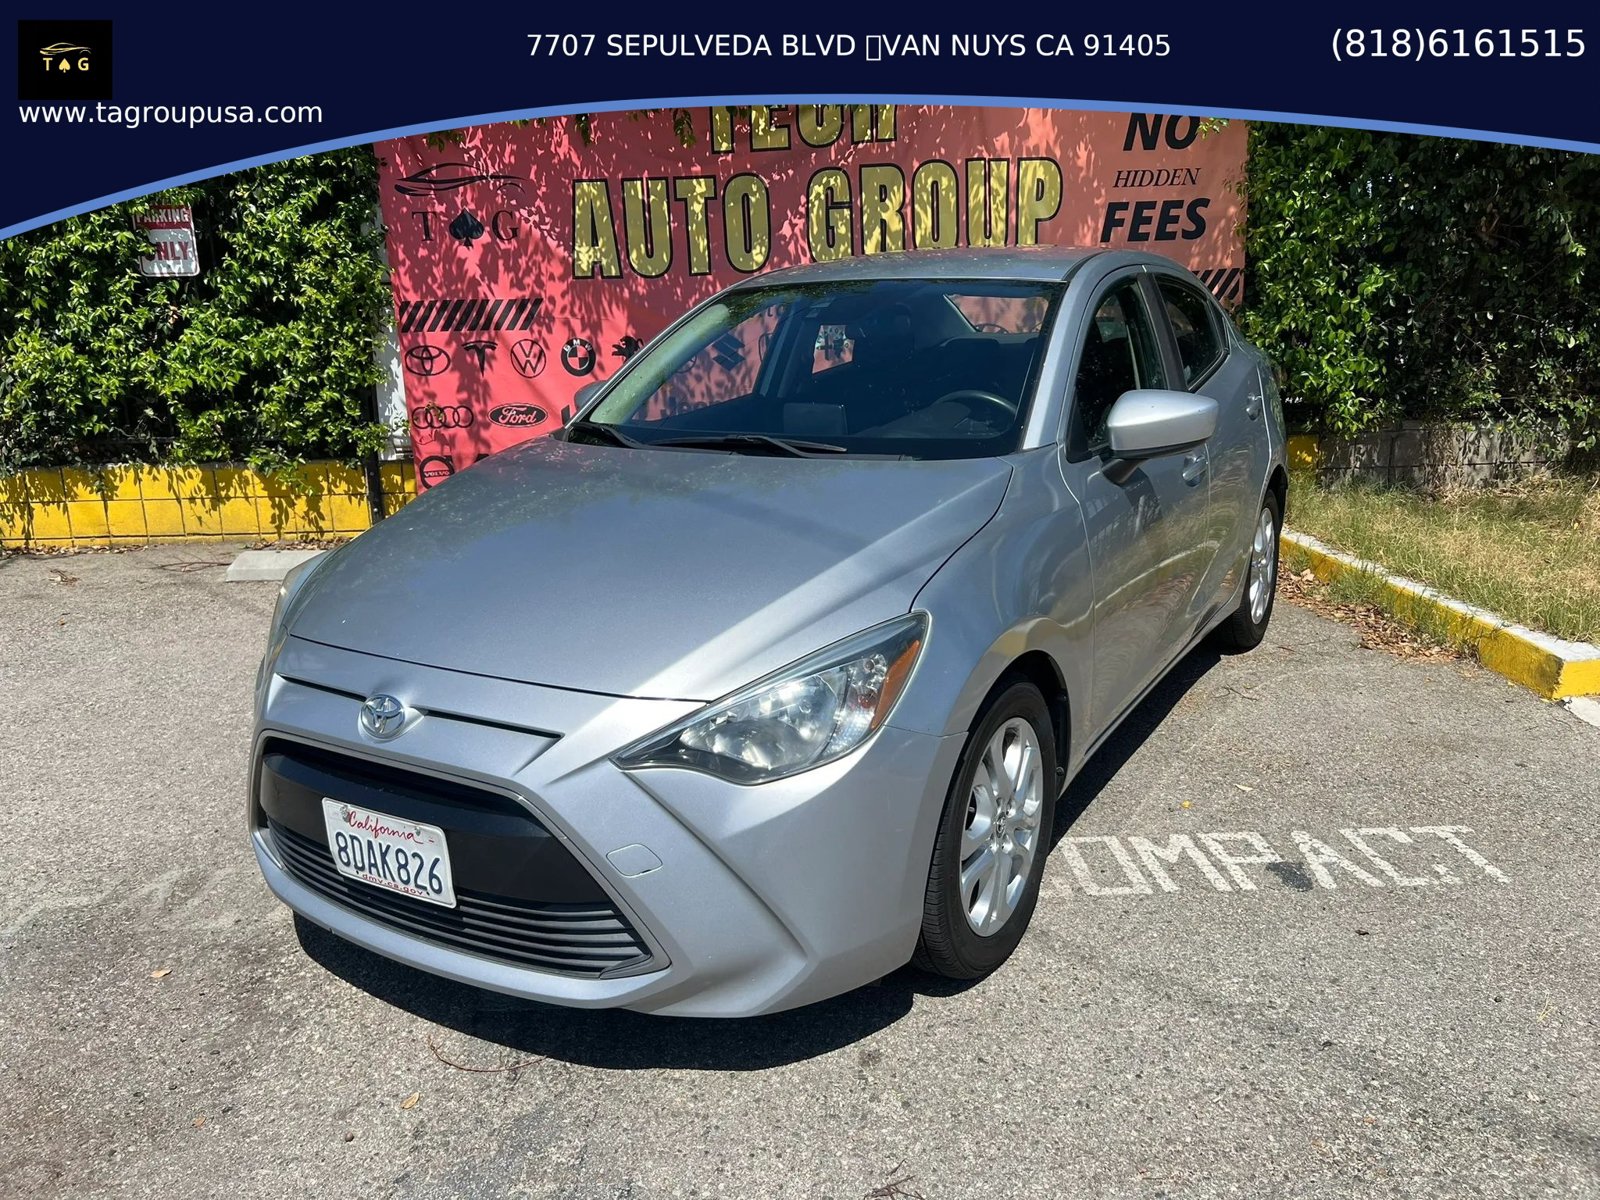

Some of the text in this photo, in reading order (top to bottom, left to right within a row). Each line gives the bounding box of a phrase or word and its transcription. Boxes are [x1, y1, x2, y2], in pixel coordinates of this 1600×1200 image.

[1122, 112, 1203, 152] NO
[1112, 167, 1202, 188] HIDDEN
[135, 207, 190, 223] PARKING
[572, 156, 1064, 280] AUTO GROUP
[1099, 197, 1211, 243] FEES
[144, 241, 189, 261] NLY
[563, 338, 593, 352] BMW
[498, 405, 537, 425] Ford
[423, 471, 450, 479] VOLVO
[348, 810, 423, 845] California
[335, 831, 443, 895] 8DAK826
[1042, 825, 1512, 897] OMPACT
[362, 872, 424, 896] dmv.ca.gov
